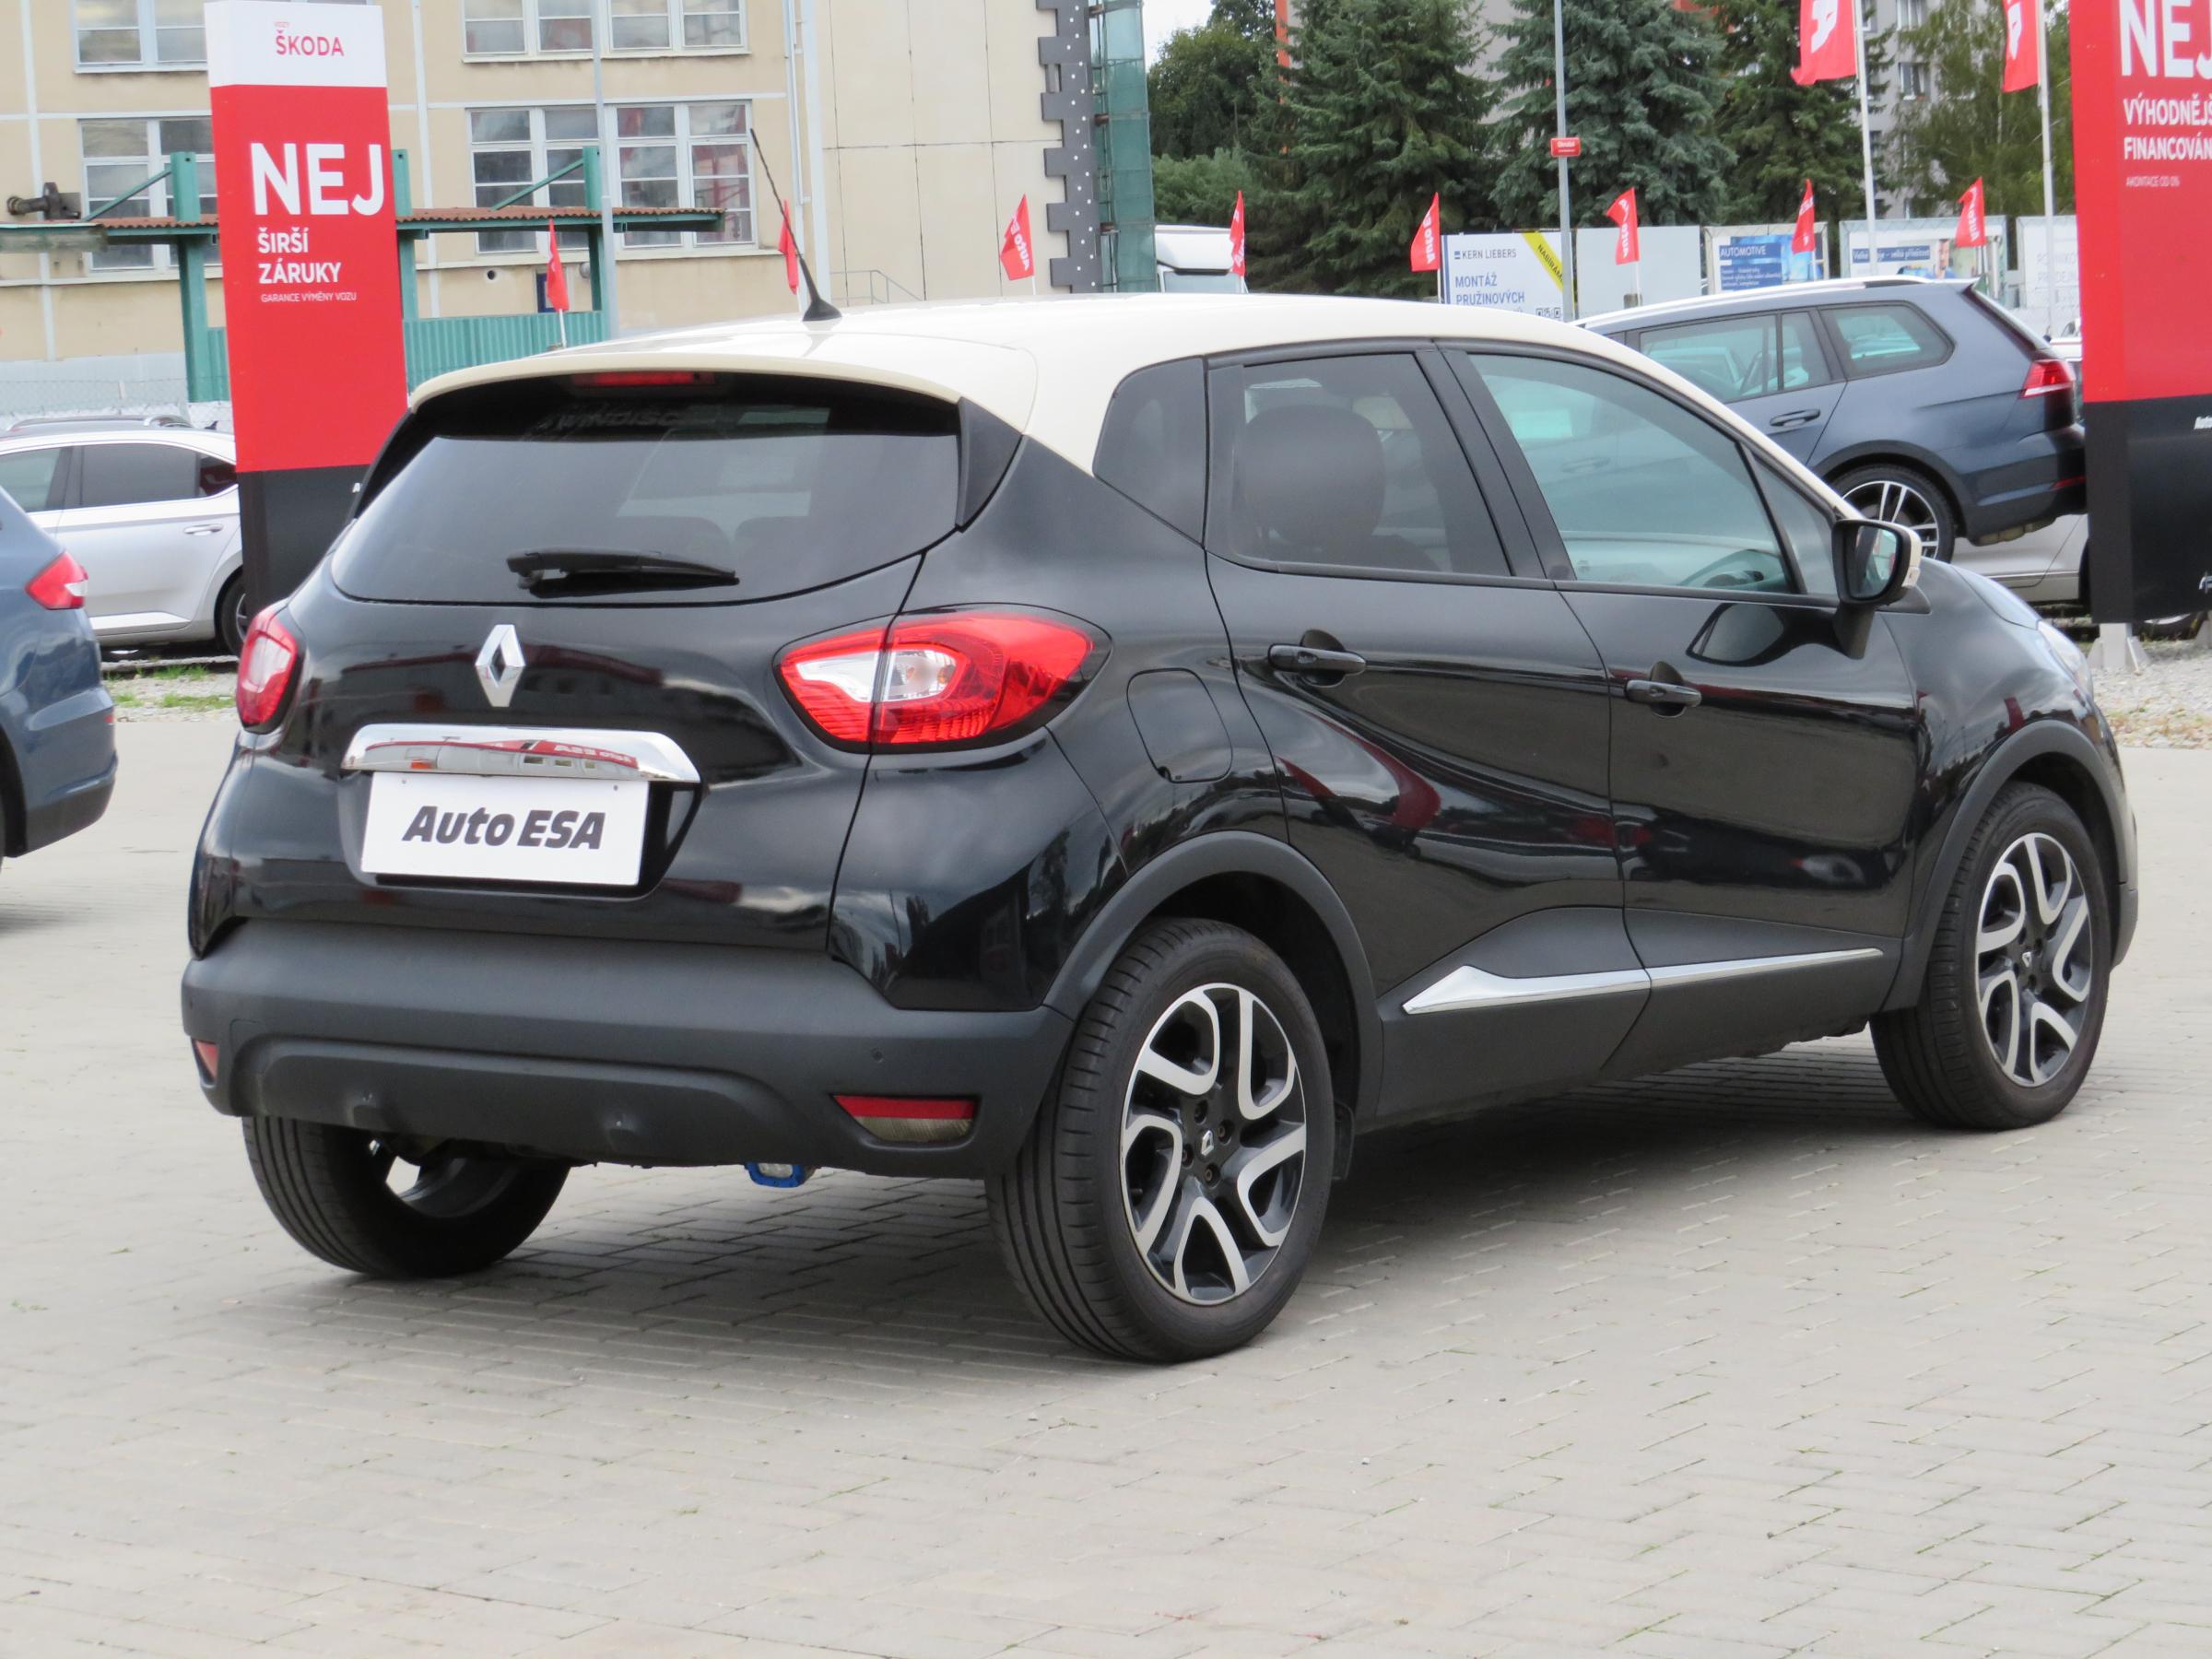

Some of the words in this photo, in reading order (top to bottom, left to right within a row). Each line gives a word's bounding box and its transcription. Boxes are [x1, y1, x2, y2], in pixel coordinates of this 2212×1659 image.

[276, 29, 345, 56] ŠKODA
[251, 142, 385, 217] NEJ
[257, 227, 310, 253] ŠIRŠÍ
[1462, 249, 1483, 260] KERN
[1485, 248, 1517, 260] LIEBERS
[1720, 245, 1767, 258] AUTOMOTIVE
[258, 258, 342, 284] ZÁRUKY
[1454, 271, 1498, 288] MONTÁŽ
[261, 293, 300, 303] GARANCE
[301, 290, 334, 302] VÝMĚNY
[335, 292, 358, 301] VOZU
[1455, 290, 1525, 305] PRUŽINOVÝCH
[402, 806, 515, 848] Auto
[516, 809, 606, 850] ESA
